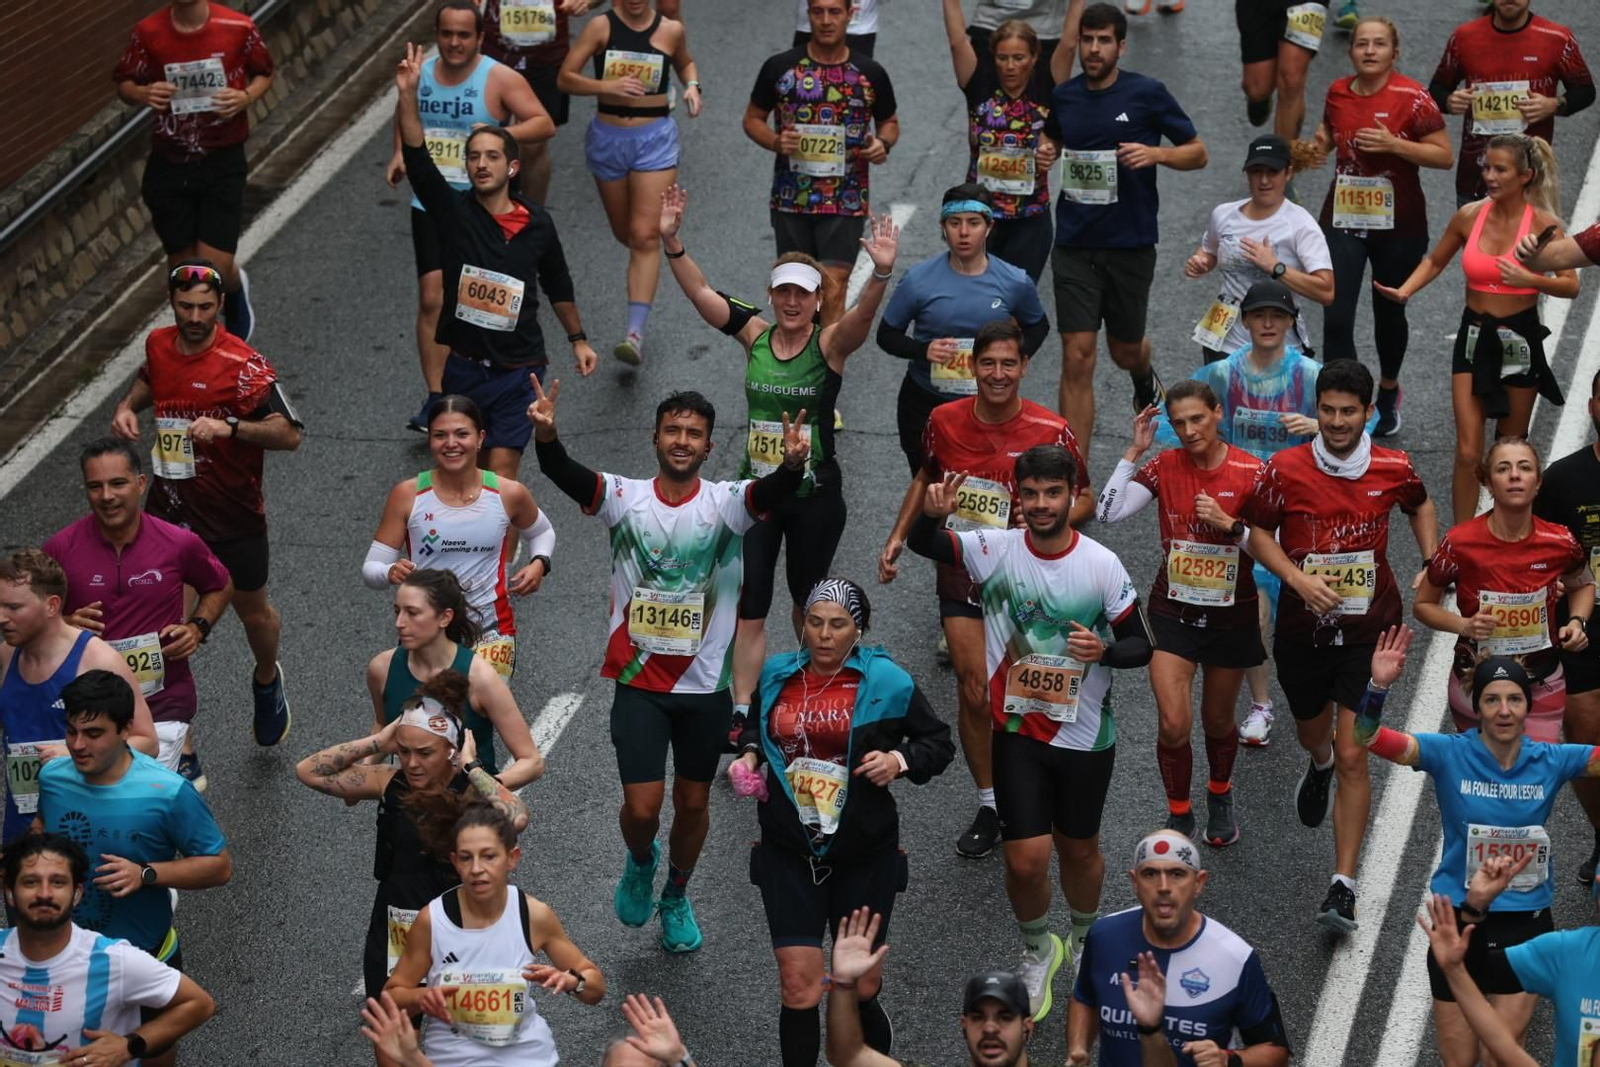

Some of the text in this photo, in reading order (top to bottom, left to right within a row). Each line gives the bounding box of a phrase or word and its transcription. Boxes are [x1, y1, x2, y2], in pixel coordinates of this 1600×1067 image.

[505, 11, 547, 25] 15178
[171, 72, 216, 90] 17442
[420, 97, 474, 119] nerja
[1477, 95, 1519, 111] 14219
[427, 141, 460, 158] 2911
[1069, 164, 1102, 181] 9825
[1340, 189, 1385, 206] 11519
[468, 281, 507, 306] 6043
[1238, 423, 1288, 443] 16639
[957, 491, 999, 514] 2585
[1173, 556, 1227, 578] 12582
[637, 604, 691, 628] 13146
[1018, 668, 1064, 692] 4858
[1460, 778, 1471, 795] MA
[1499, 783, 1518, 799] POUR
[1518, 784, 1545, 800] L'ESPOIR
[447, 989, 512, 1012] 14661
[1100, 1005, 1208, 1037] QUITES
